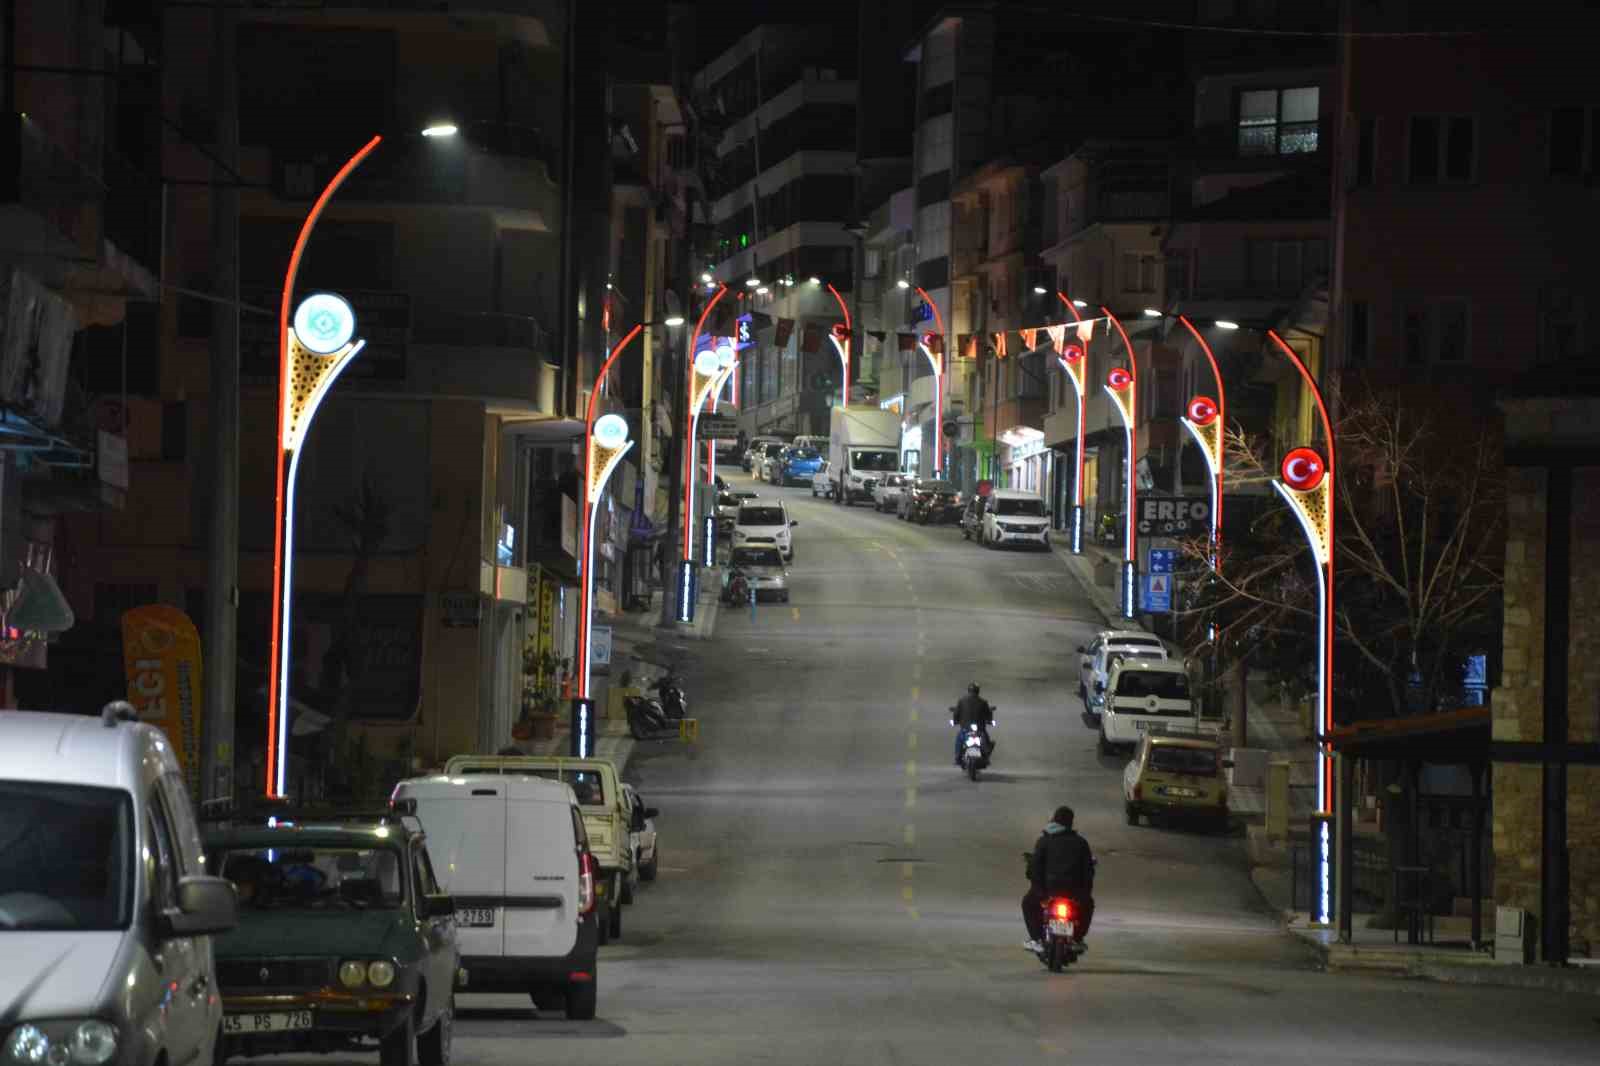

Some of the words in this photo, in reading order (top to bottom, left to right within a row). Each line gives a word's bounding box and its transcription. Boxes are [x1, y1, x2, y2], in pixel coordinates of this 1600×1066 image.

[225, 1014, 241, 1030] 45
[254, 1014, 272, 1029] PS
[286, 1010, 310, 1027] 726
